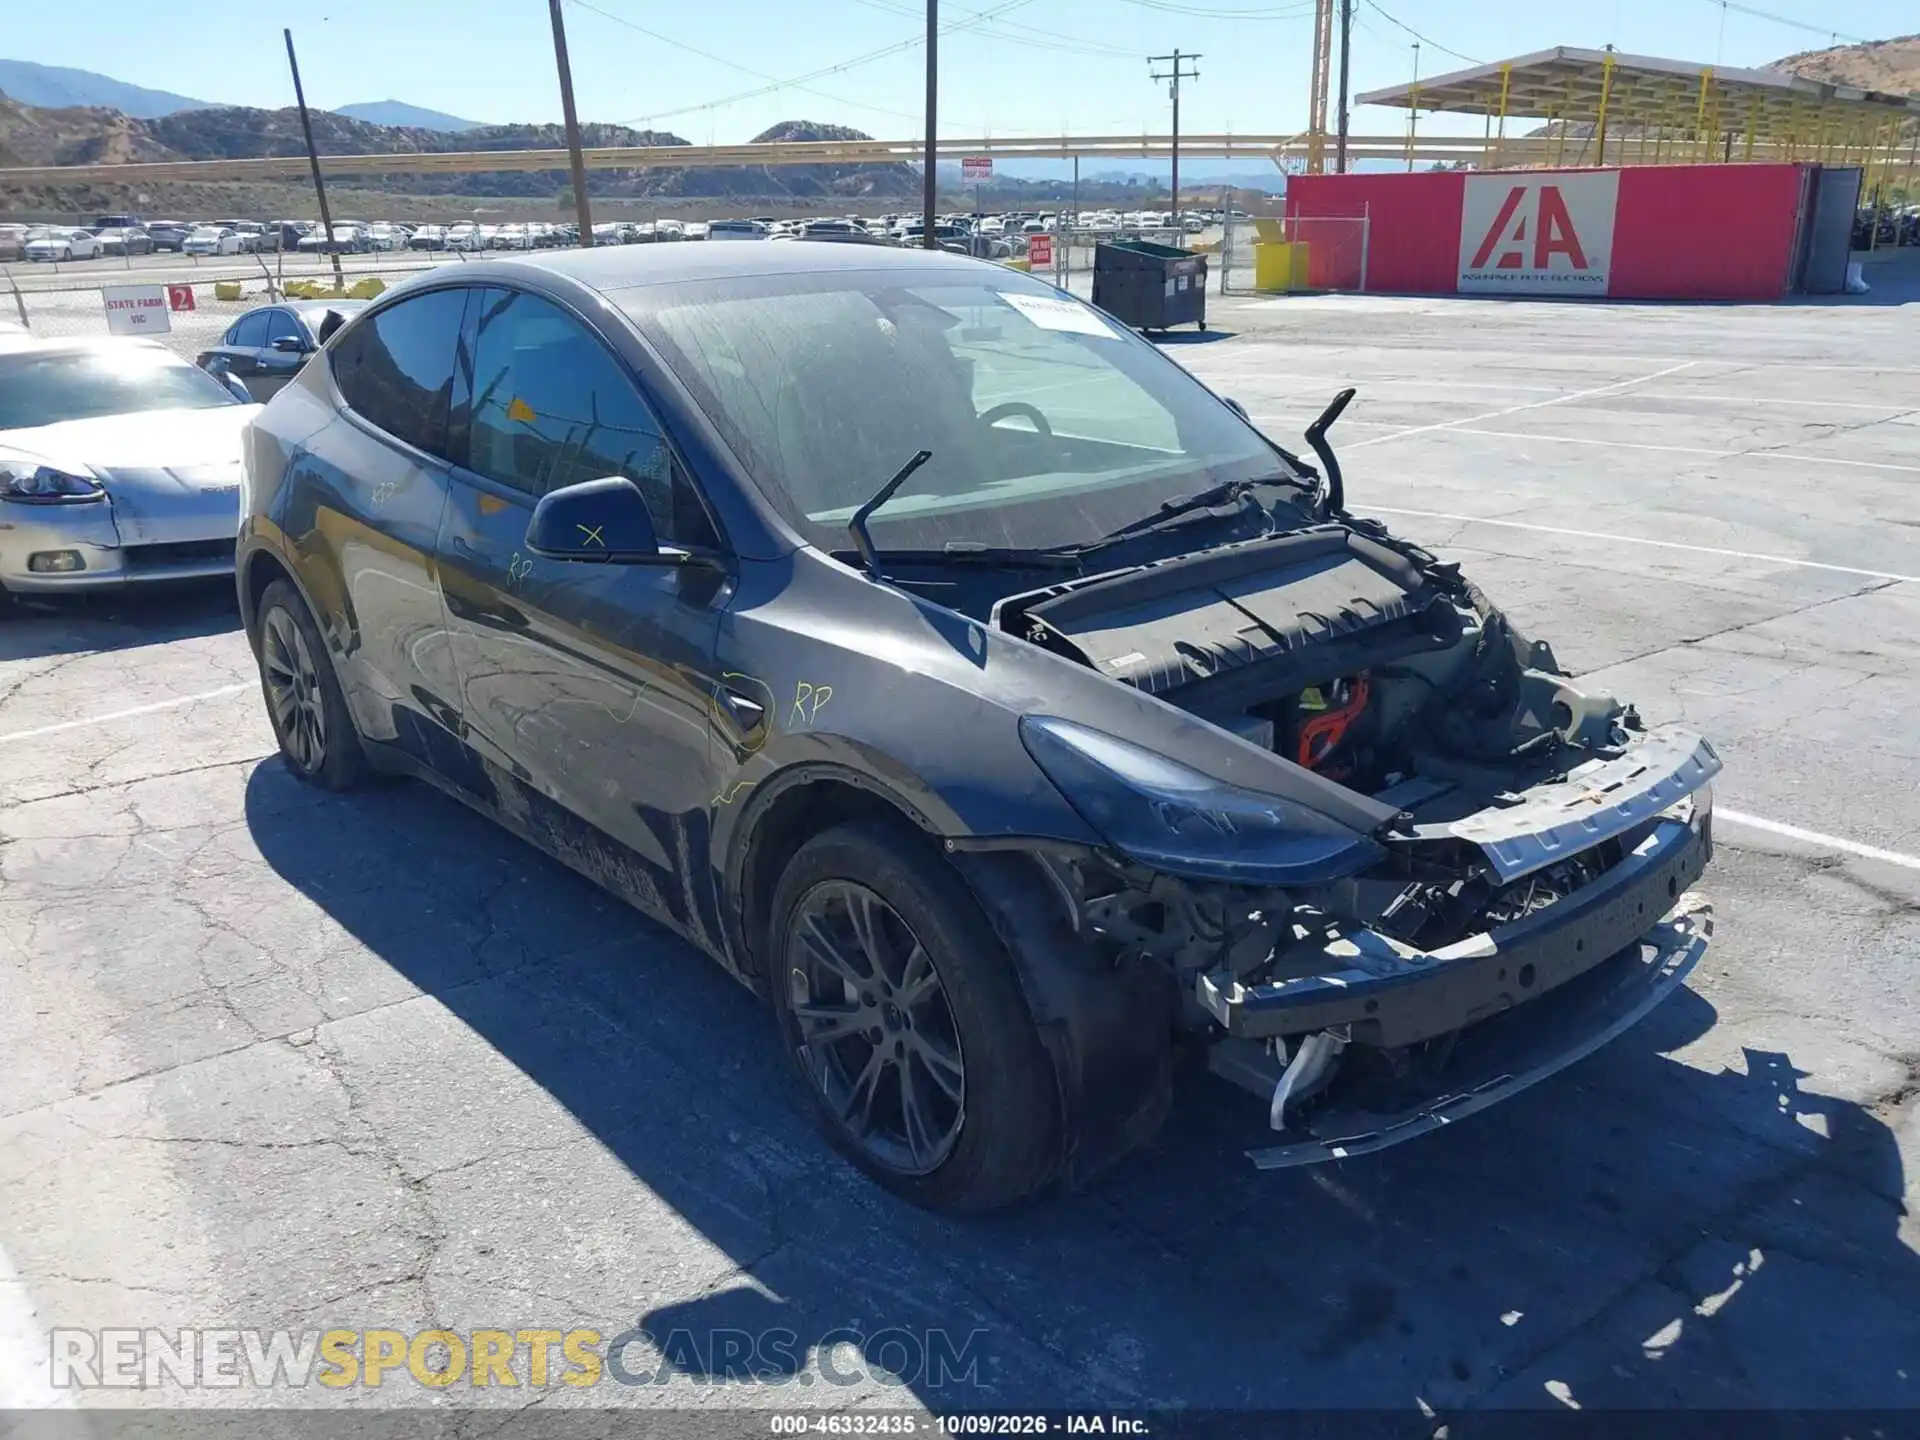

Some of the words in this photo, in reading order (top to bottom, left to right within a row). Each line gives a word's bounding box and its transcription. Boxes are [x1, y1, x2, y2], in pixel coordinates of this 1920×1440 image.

[107, 299, 135, 310] STATE
[174, 289, 189, 309] 2
[788, 681, 833, 726] RP
